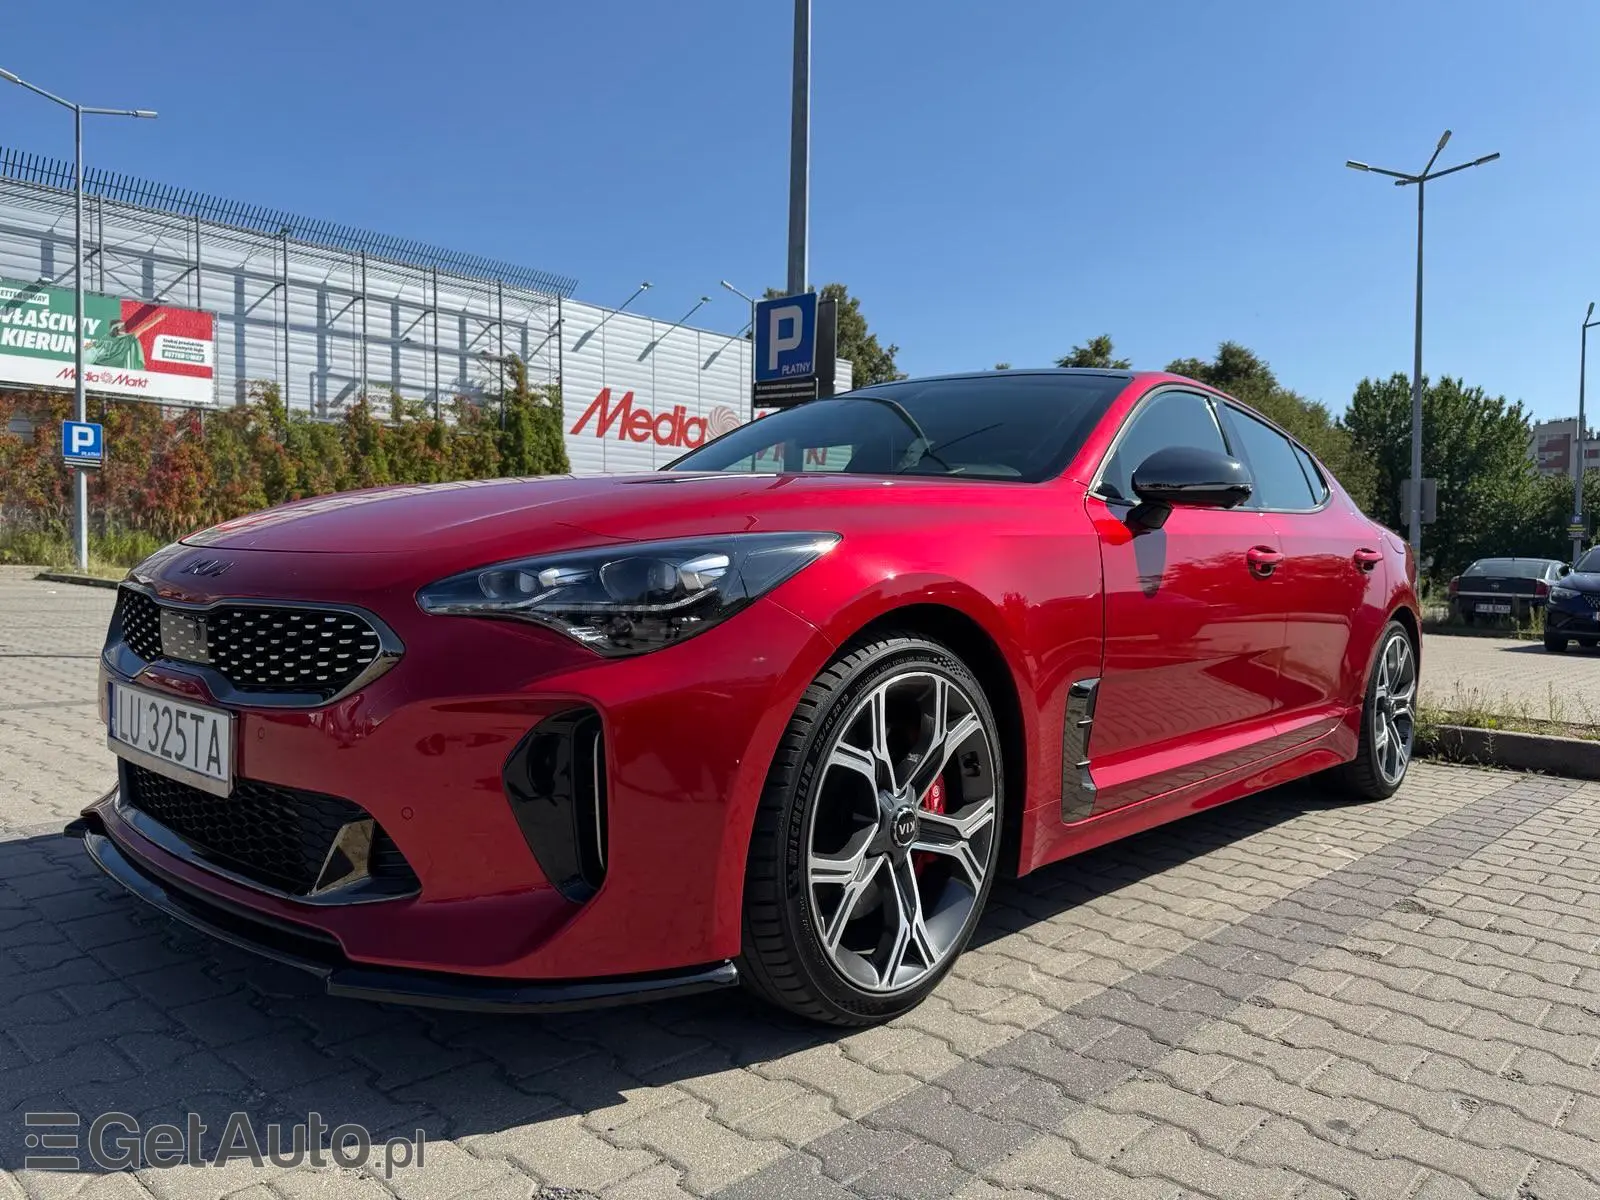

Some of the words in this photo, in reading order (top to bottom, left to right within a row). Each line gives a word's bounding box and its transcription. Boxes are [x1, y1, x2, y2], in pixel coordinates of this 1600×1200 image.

[0, 289, 23, 299] ETTER
[0, 305, 101, 336] WŁAŚCIWY
[1, 327, 96, 354] KIERUN
[768, 305, 804, 371] P
[56, 367, 99, 383] Mdia
[112, 373, 149, 389] Markt
[781, 361, 811, 376] PŁATNY
[570, 387, 709, 449] Media
[72, 425, 95, 453] P
[119, 690, 140, 746] LU
[148, 702, 222, 776] 325TA
[898, 820, 916, 836] KIA
